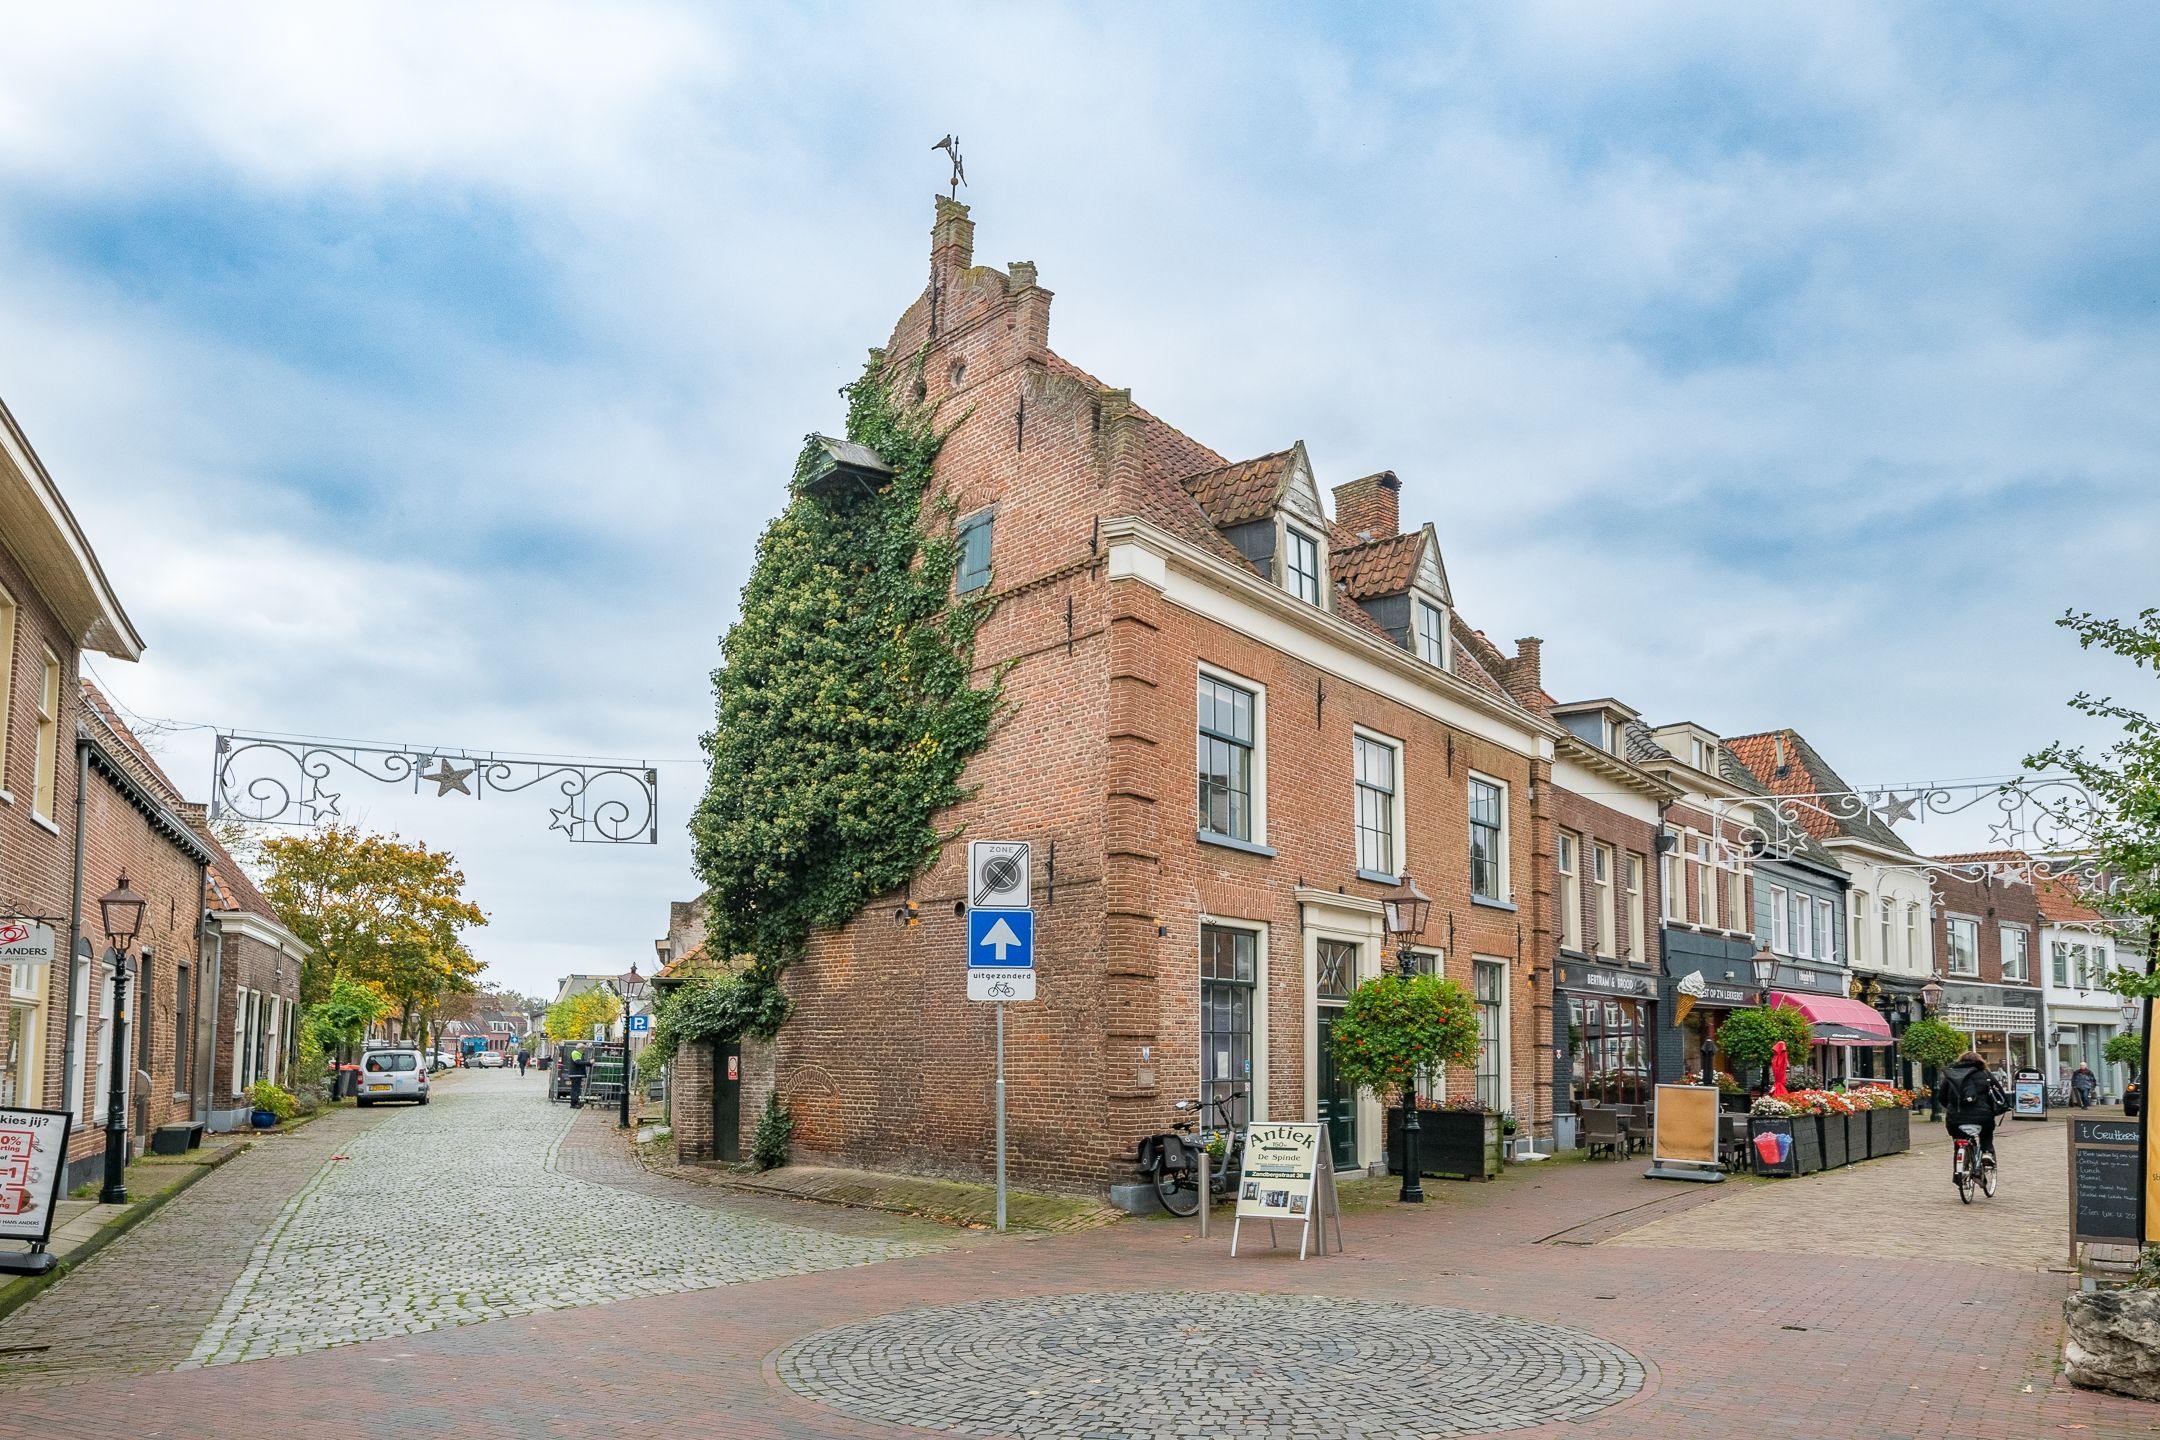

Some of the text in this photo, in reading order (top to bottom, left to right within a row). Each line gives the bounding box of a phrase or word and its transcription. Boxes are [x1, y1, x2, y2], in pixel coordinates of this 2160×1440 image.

[989, 846, 1014, 854] ZONE
[5, 947, 47, 955] ANDERS
[973, 972, 1031, 981] uitgezonderd
[1587, 973, 1634, 989] BERTRAM & BROOD
[1710, 989, 1716, 998] OP
[0, 1114, 50, 1128] kies jij?
[1251, 1127, 1315, 1149] Antiek
[1273, 1154, 1300, 1162] Spinde
